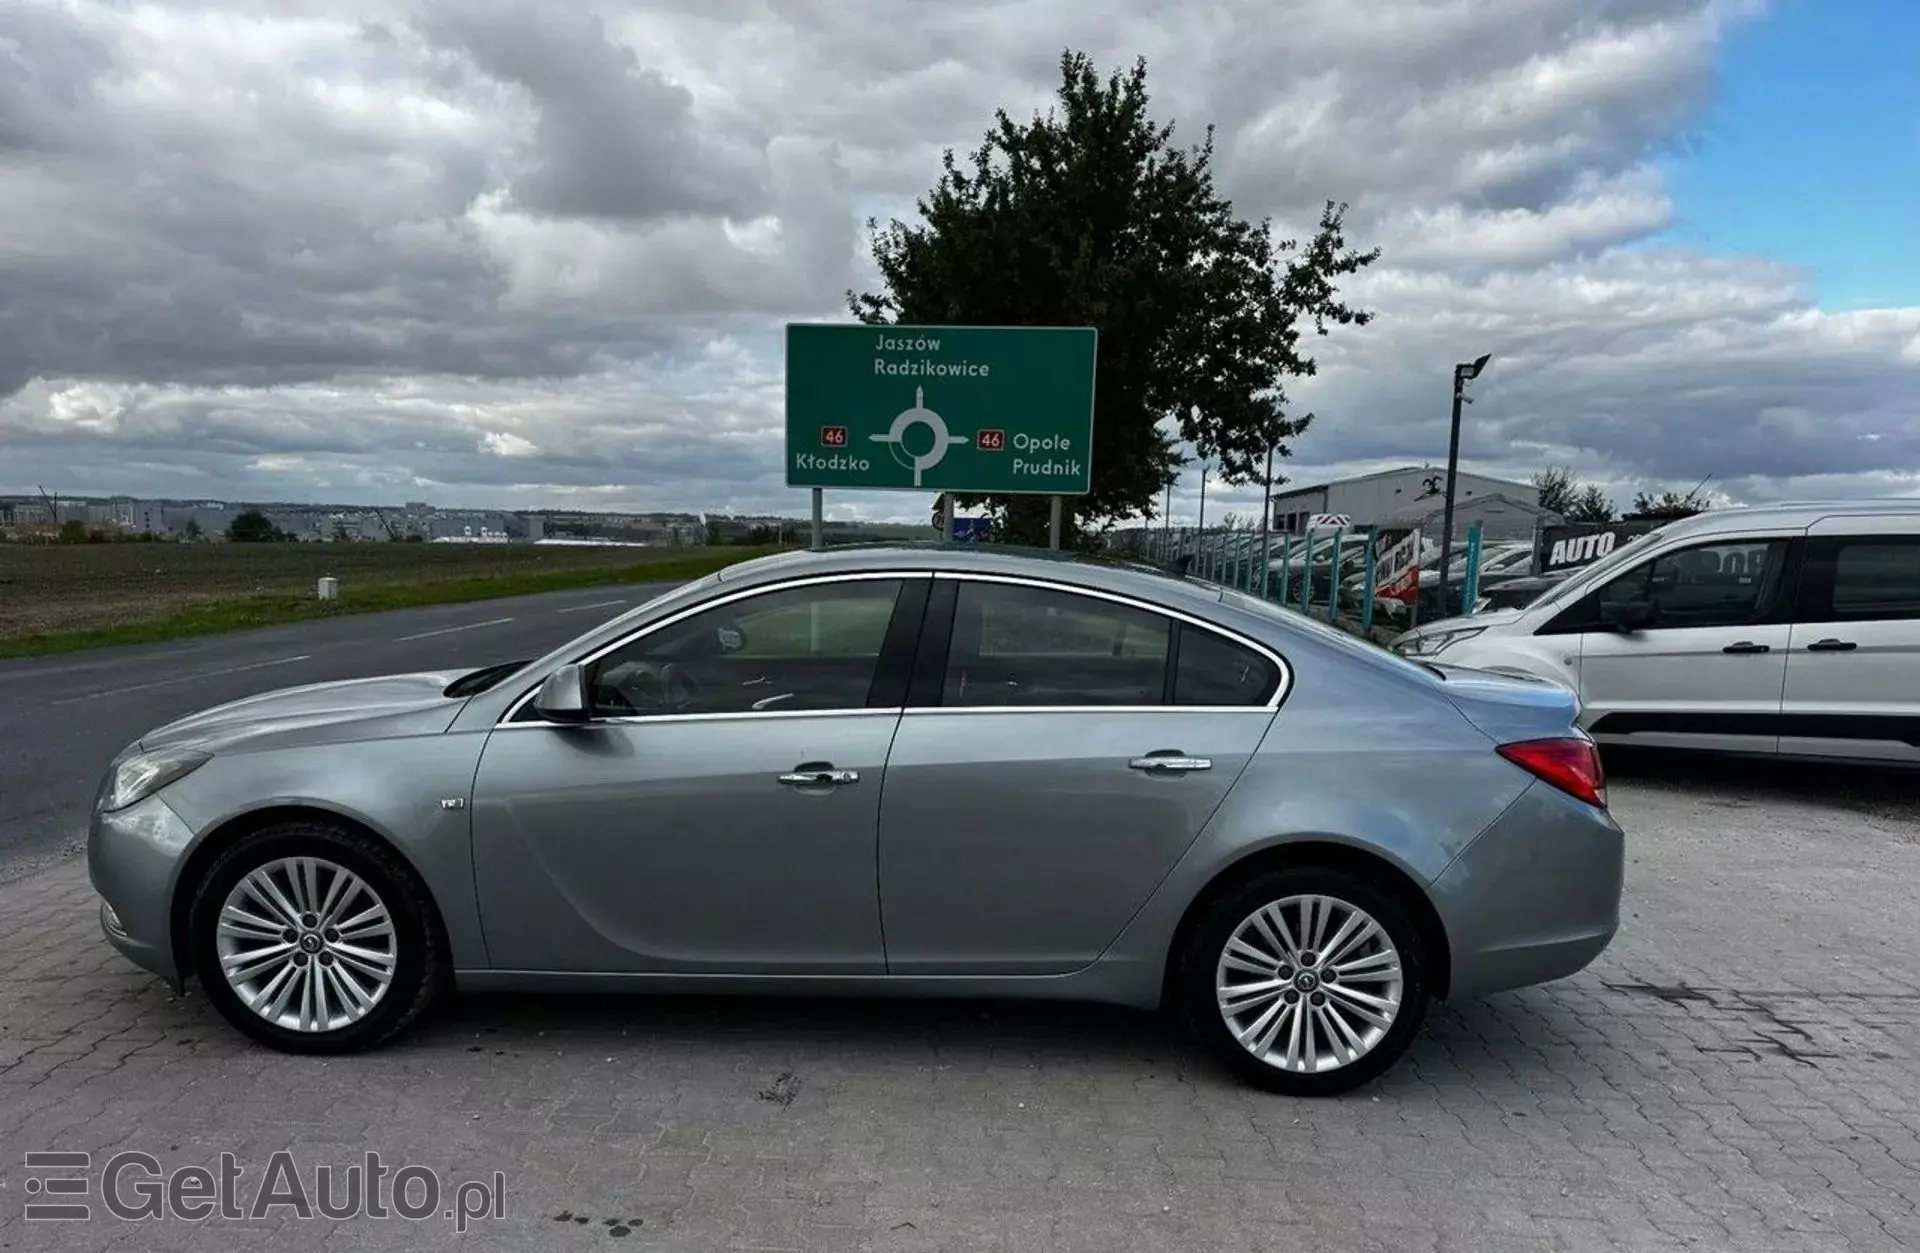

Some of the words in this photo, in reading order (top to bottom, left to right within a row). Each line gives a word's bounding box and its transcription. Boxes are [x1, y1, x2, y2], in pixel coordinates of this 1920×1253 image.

[875, 334, 941, 351] Jaszów
[874, 358, 990, 377] Radzikowice
[824, 430, 844, 444] 46
[980, 433, 1000, 447] 46
[1013, 433, 1071, 453] Opole
[796, 453, 870, 472] Kłodzko
[1013, 459, 1081, 476] Prudnik
[1549, 531, 1616, 565] AUTO
